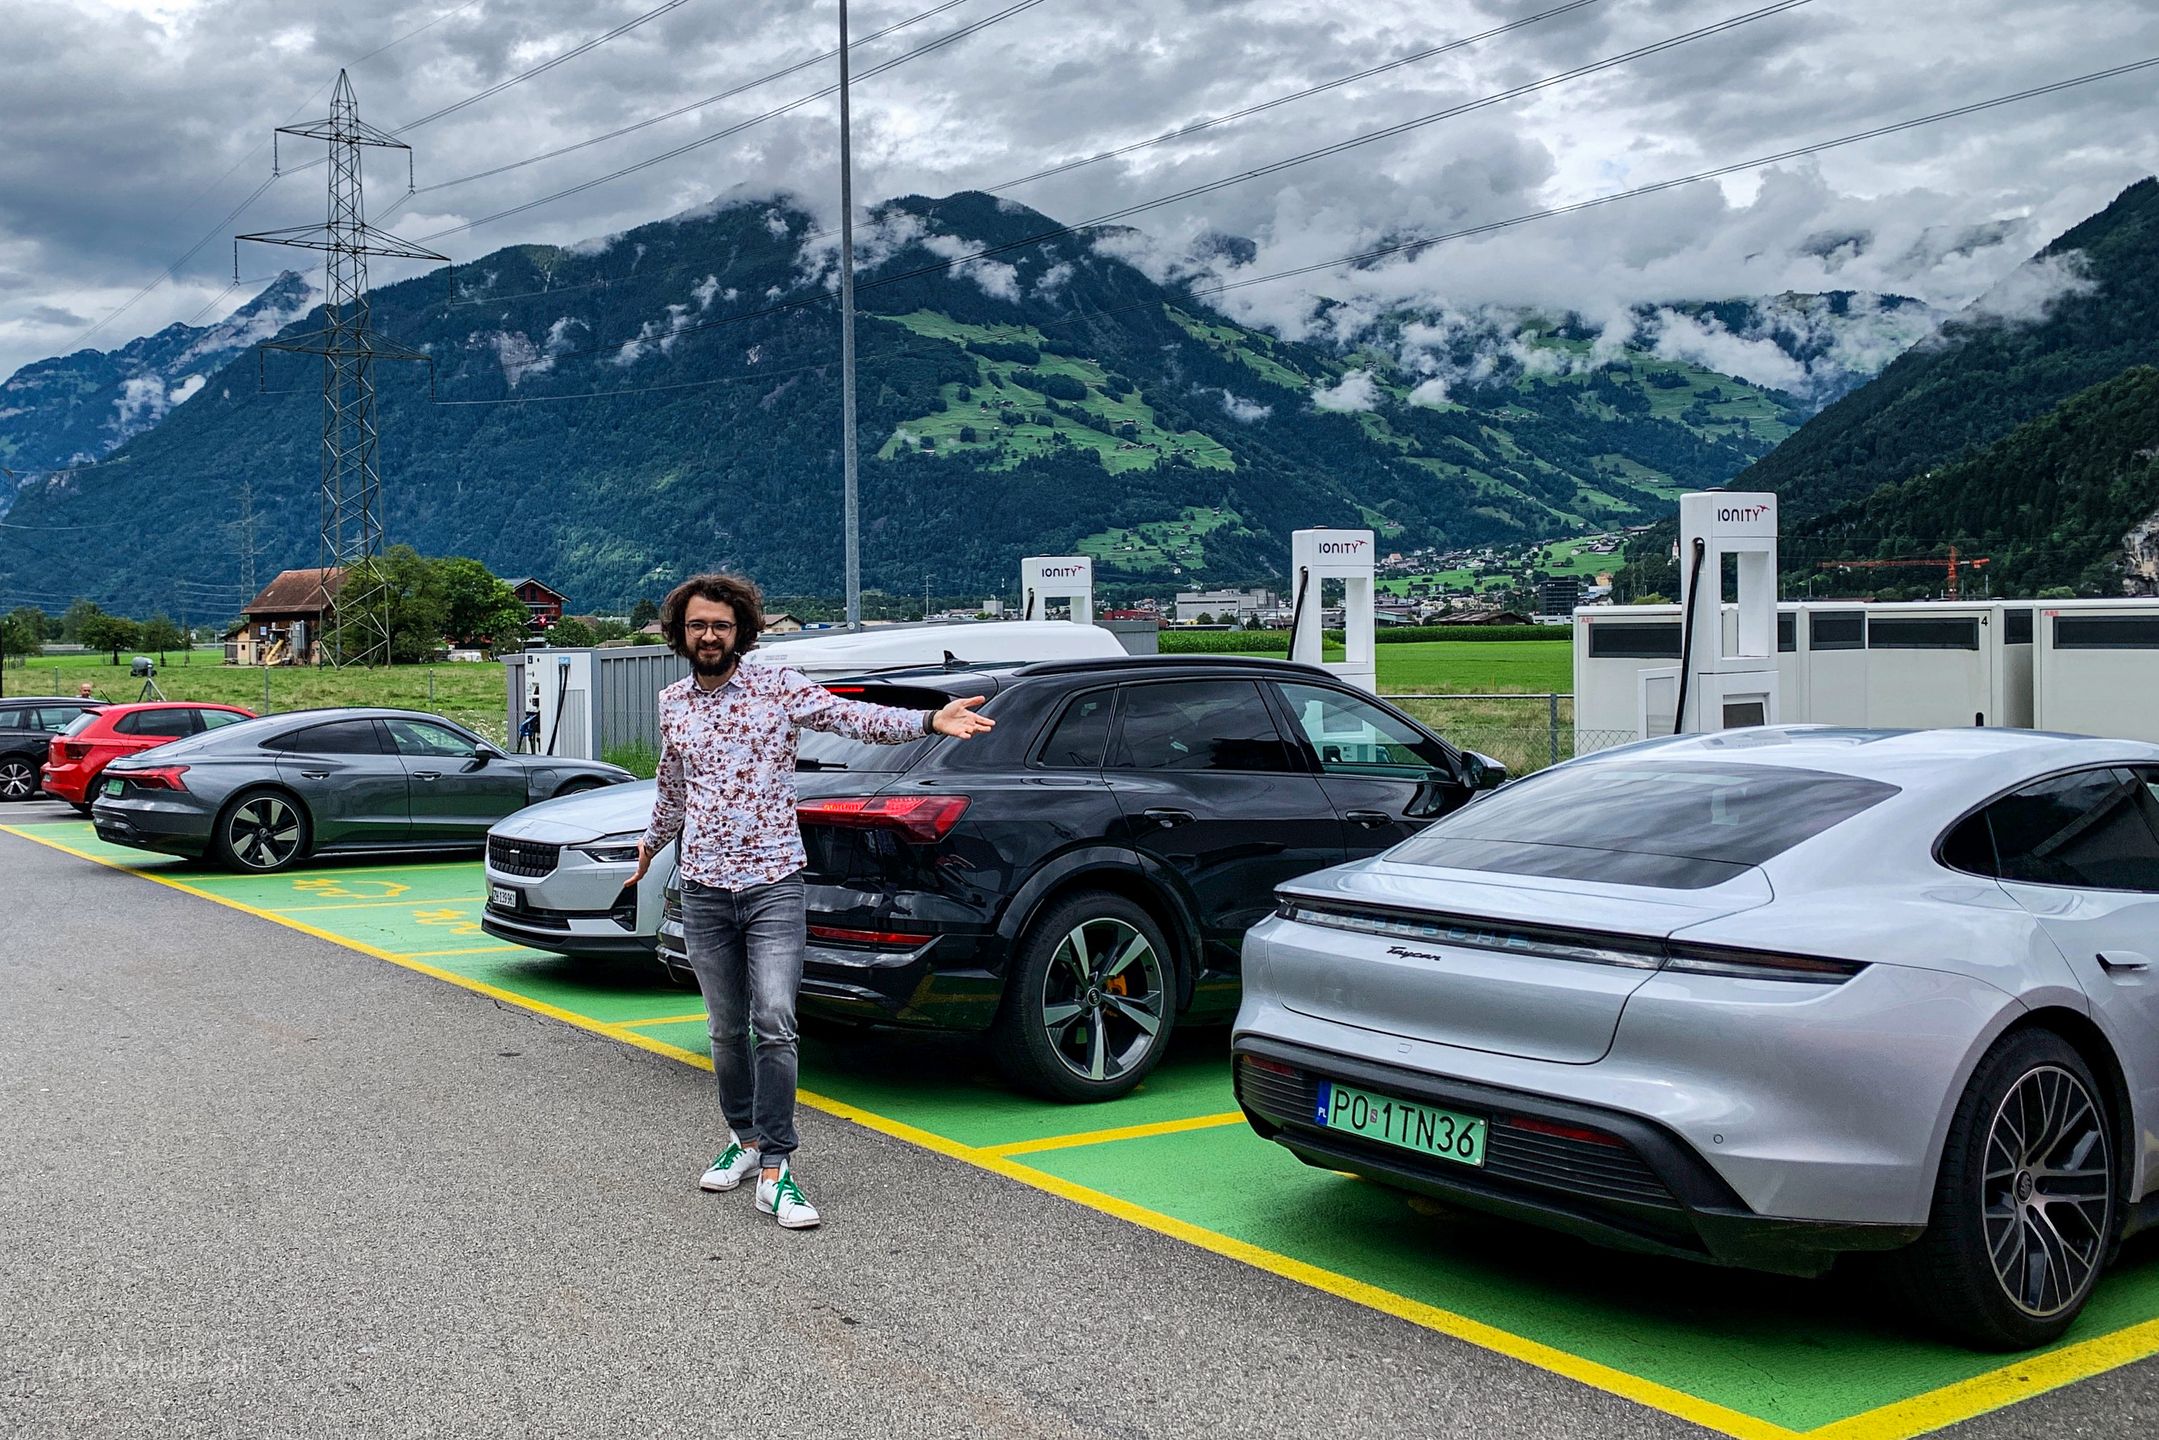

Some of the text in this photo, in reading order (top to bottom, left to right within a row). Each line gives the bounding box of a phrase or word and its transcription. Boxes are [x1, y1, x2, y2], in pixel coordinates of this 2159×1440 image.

[1717, 508, 1761, 522] IONITY
[1318, 542, 1359, 554] IONITY
[1041, 567, 1078, 578] IONITY
[1981, 616, 1988, 626] 4
[1386, 946, 1441, 961] Taycan
[1318, 1107, 1327, 1118] PL
[1382, 1102, 1476, 1157] 1TN36
